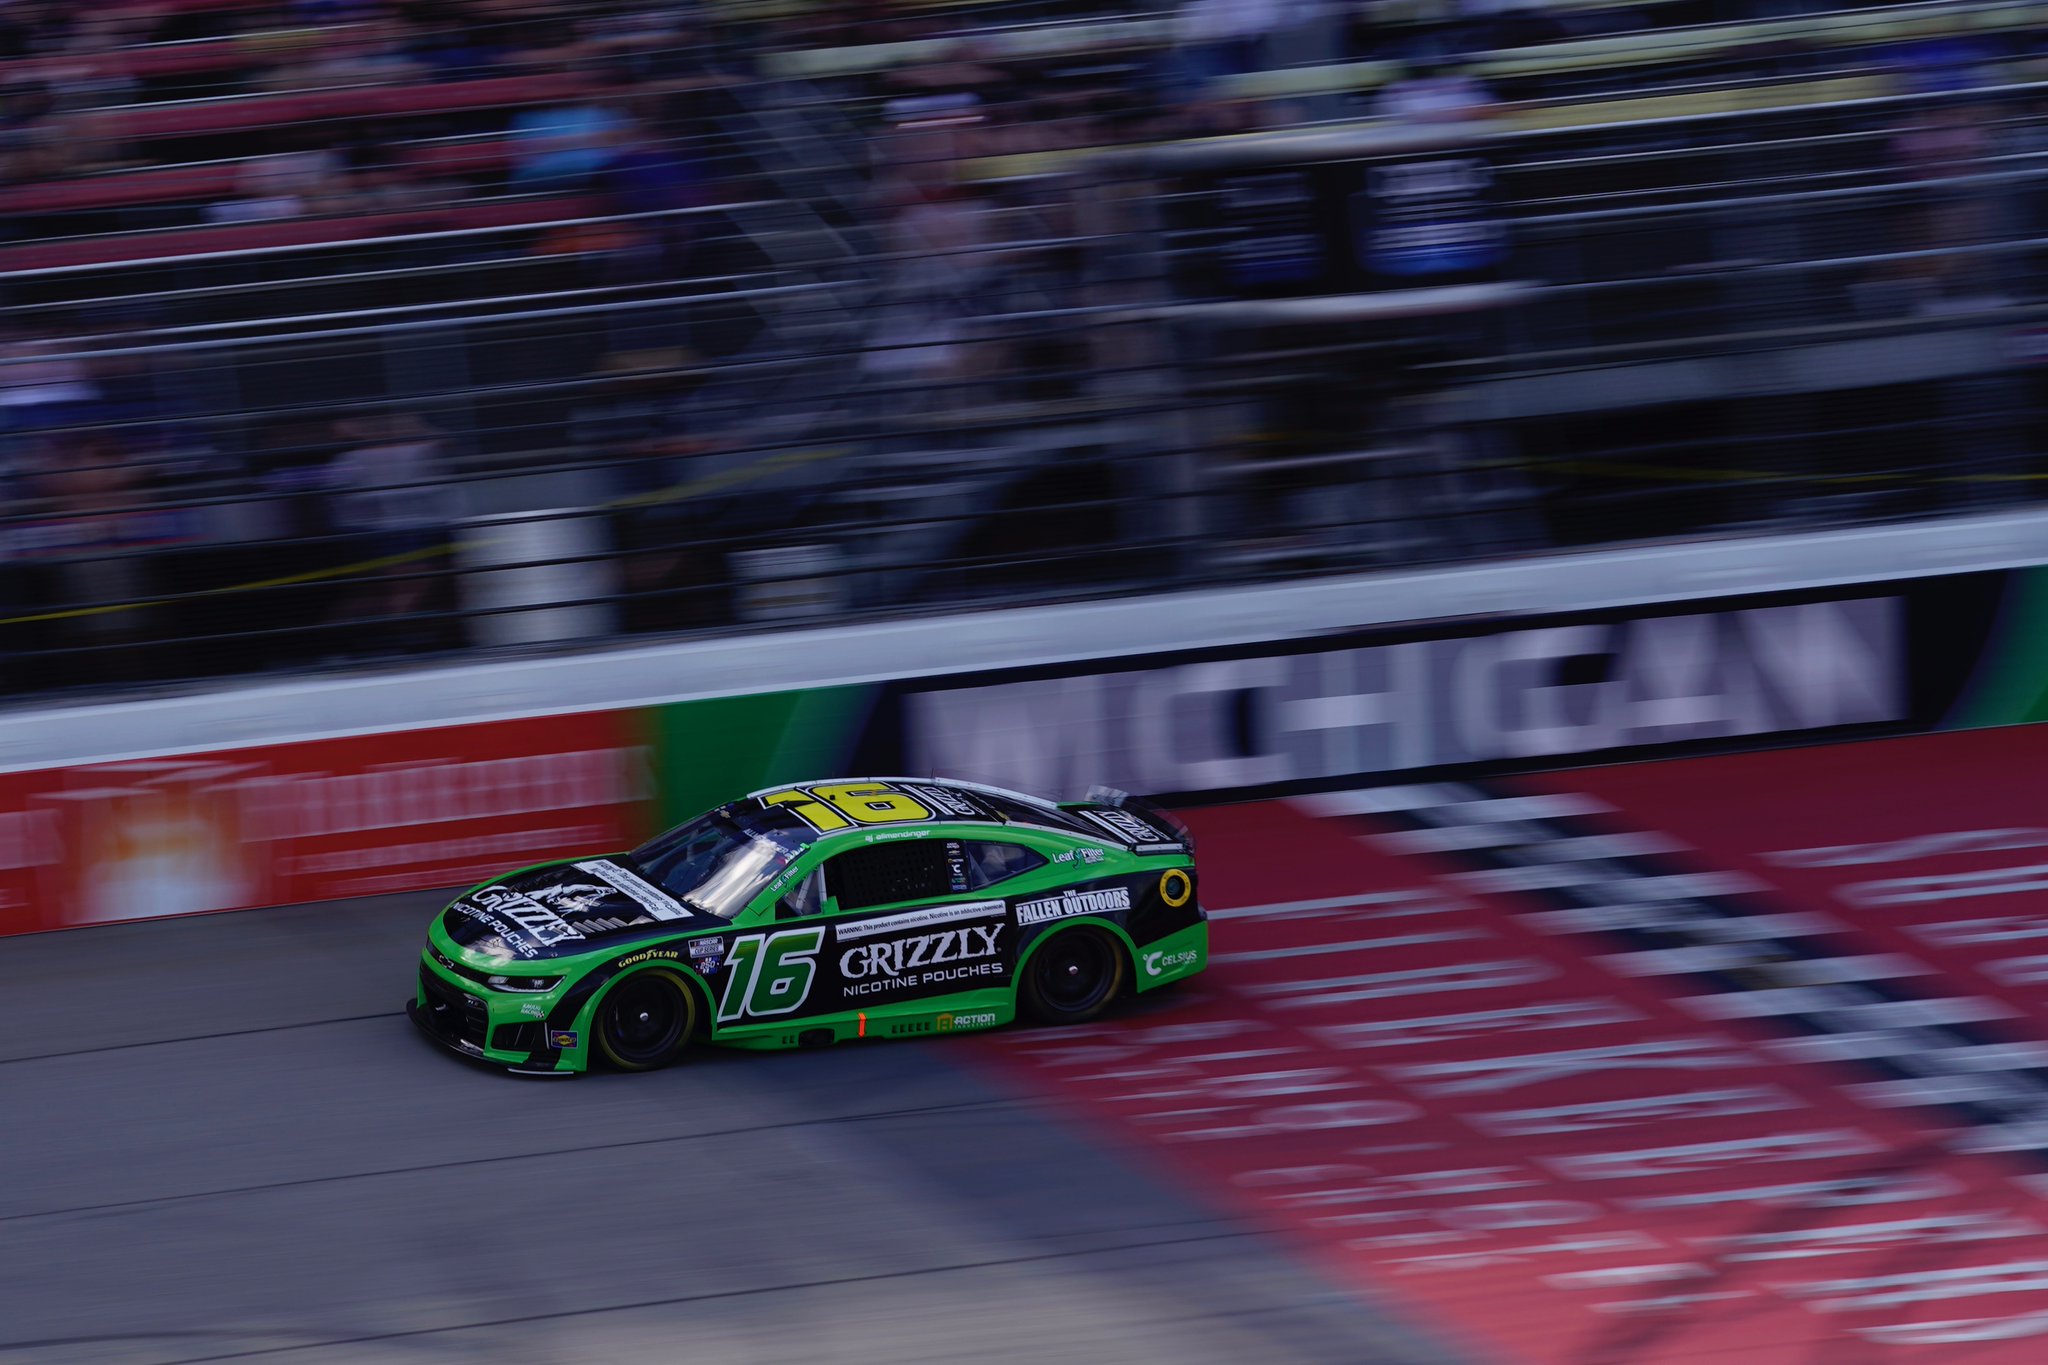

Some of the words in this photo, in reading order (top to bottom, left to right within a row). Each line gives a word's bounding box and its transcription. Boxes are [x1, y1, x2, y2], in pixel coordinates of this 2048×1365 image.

[758, 781, 937, 836] 16
[1016, 901, 1062, 923] FALLEN
[1062, 889, 1131, 915] OUTDOORS
[1063, 889, 1077, 898] THE
[453, 901, 494, 923] NICOTINE
[488, 920, 538, 958] POUCHES
[471, 885, 586, 947] GRIZZLY
[618, 949, 678, 968] GOODYEAR
[839, 922, 1005, 979] GRIZZLY
[1162, 950, 1198, 966] CELSIUS
[717, 926, 826, 1022] 16
[843, 975, 918, 997] NICOTINE
[922, 962, 1003, 984] POUCHES
[954, 1012, 996, 1025] ACTION
